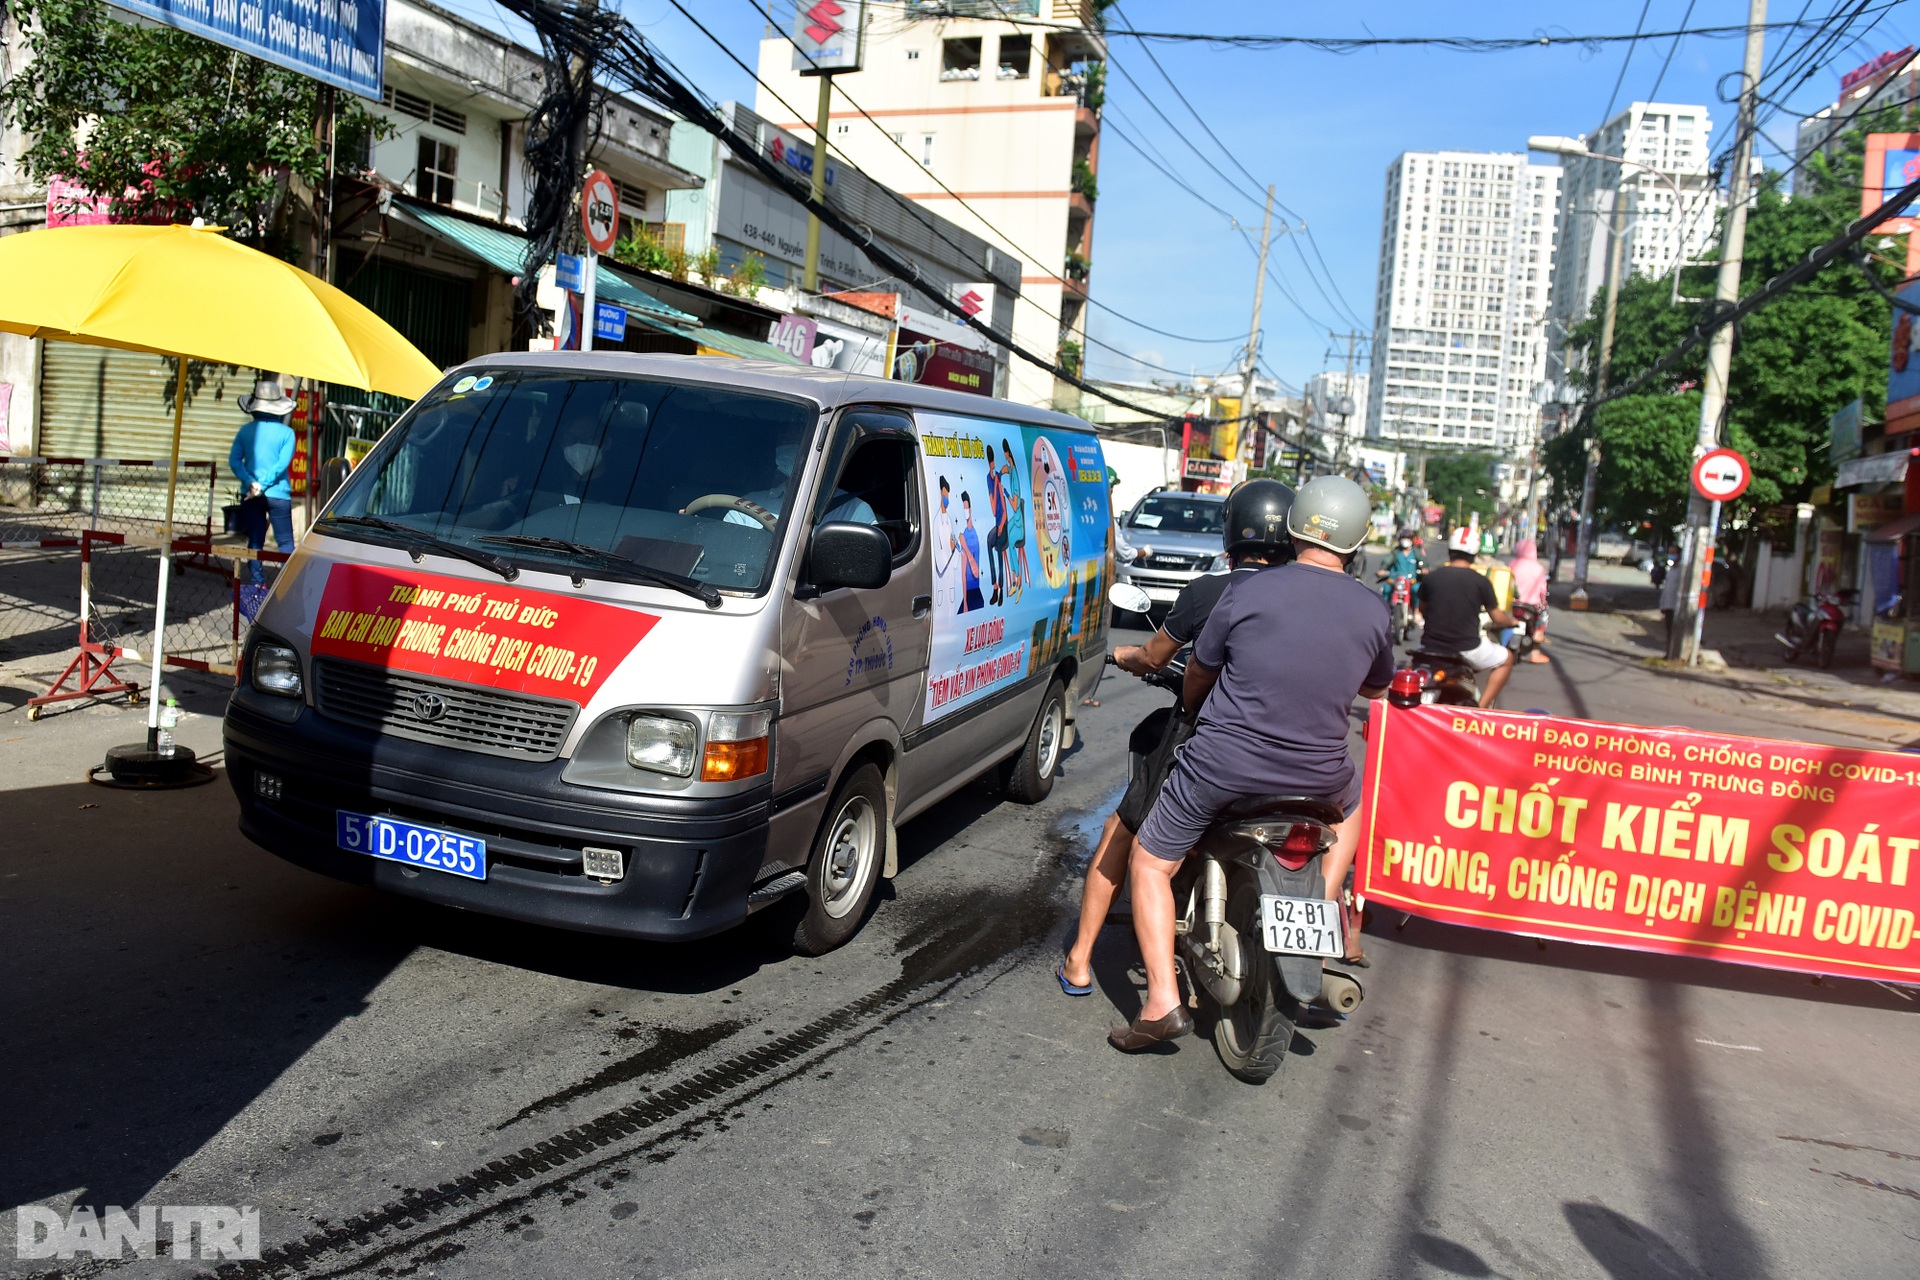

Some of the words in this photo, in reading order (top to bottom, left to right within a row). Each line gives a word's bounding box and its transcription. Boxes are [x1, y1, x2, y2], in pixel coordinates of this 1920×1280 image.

[239, 0, 266, 40] CHỦ,
[268, 10, 297, 48] CÔNG
[298, 17, 328, 65] BẰNG,
[330, 37, 350, 69] VĂN
[743, 223, 776, 247] 438-440
[767, 321, 806, 360] 446
[922, 431, 946, 457] THÀNH
[945, 432, 959, 458] PHỐ
[959, 433, 972, 459] THỦ
[971, 436, 985, 459] ĐỨC
[1047, 491, 1057, 511] 5K
[1320, 520, 1339, 528] mobile
[388, 584, 450, 611] THÀNH
[450, 592, 488, 614] PHỐ
[485, 598, 522, 621] THỦ
[517, 606, 559, 629] ĐỨC
[320, 609, 350, 640] BAN
[347, 606, 383, 643] CHỈ
[368, 616, 402, 652] ĐẠO
[394, 615, 446, 659] PHÒNG,
[441, 623, 496, 667] CHỐNG
[493, 637, 530, 675] DỊCH
[526, 643, 599, 688] COVID-19
[852, 620, 871, 656] PHÒNG
[964, 627, 974, 655] XE
[987, 616, 1004, 651] ĐỘNG
[949, 663, 964, 703] VẮC
[963, 669, 977, 697] XIN
[976, 656, 998, 691] PHÒNG
[1452, 717, 1495, 735] BAN
[1501, 721, 1539, 741] CHỈ
[1543, 729, 1589, 749] ĐẠO
[1595, 735, 1677, 761] PHÒNG,
[1684, 743, 1763, 769] CHỐNG
[1769, 754, 1823, 776] DỊCH
[1533, 752, 1624, 779] PHƯỜNG
[1629, 759, 1681, 785] BÌNH
[1688, 772, 1765, 796] TRƯNG
[1770, 778, 1836, 803] ĐÔNG
[345, 816, 476, 872] 51D-0255
[1444, 778, 1588, 844] CHỐT
[1602, 793, 1750, 867] KIỂM
[1767, 823, 1920, 886] SOÁT
[1382, 835, 1497, 901] PHÒNG,
[1507, 850, 1618, 905] CHỐNG
[1626, 875, 1706, 927] DỊCH
[1712, 881, 1807, 939] BỆNH
[1274, 900, 1325, 926] 62-B1
[1270, 925, 1337, 953] 128.71
